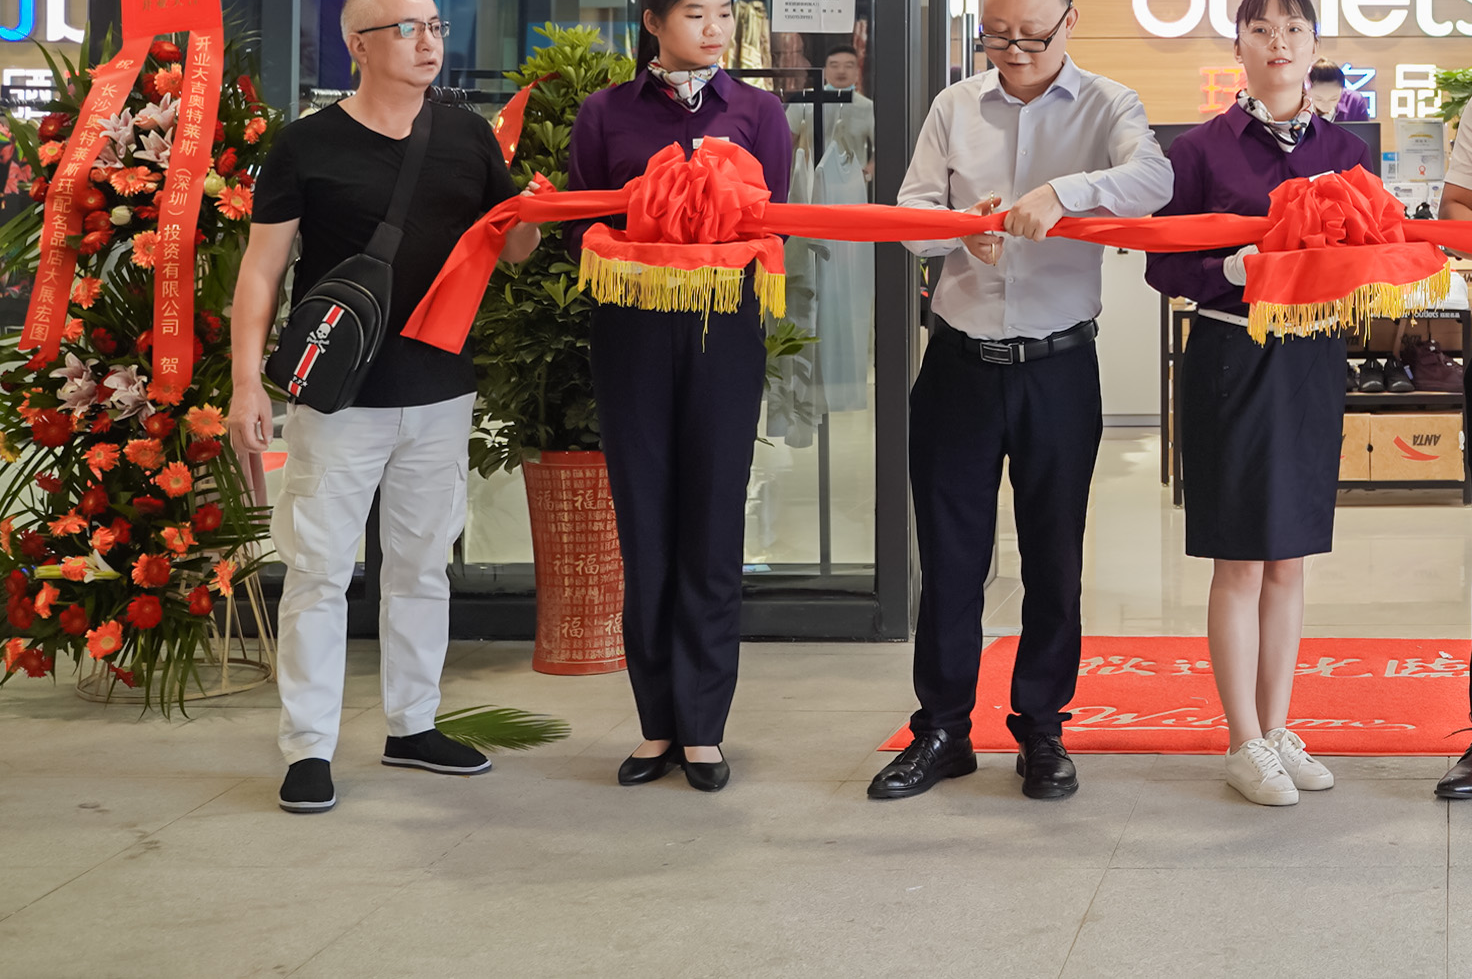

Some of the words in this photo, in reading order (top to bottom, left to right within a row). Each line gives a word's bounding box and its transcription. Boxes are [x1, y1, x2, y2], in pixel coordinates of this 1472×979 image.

[161, 357, 179, 374] 贺
[1412, 433, 1442, 447] ANTA
[576, 553, 600, 576] 福
[561, 616, 584, 639] 福
[1065, 705, 1416, 733] Welme
